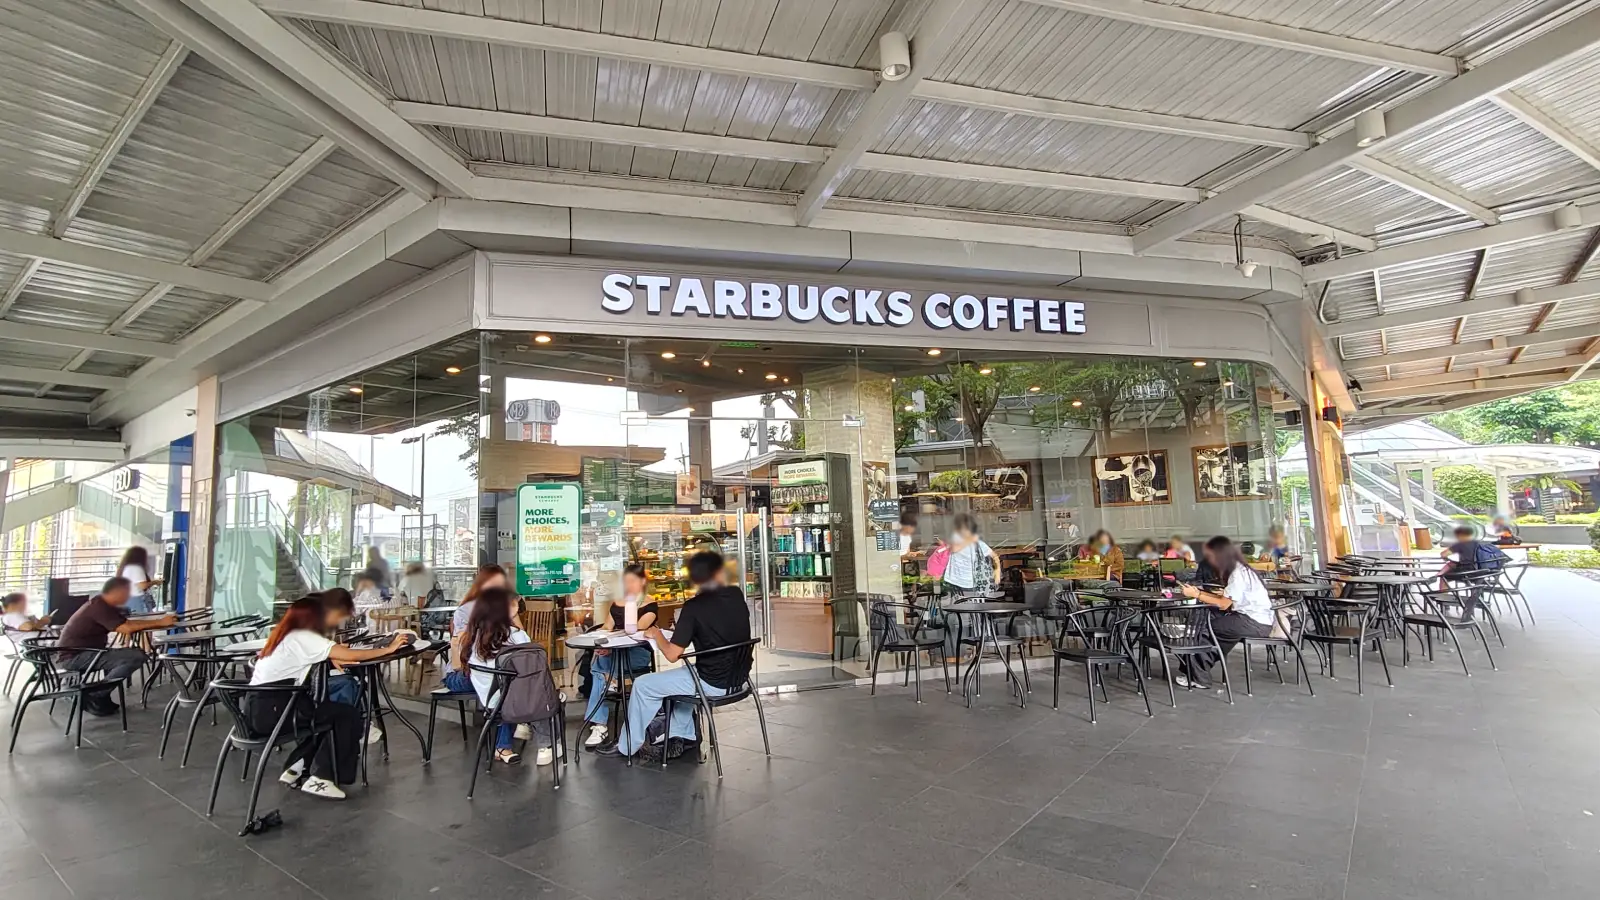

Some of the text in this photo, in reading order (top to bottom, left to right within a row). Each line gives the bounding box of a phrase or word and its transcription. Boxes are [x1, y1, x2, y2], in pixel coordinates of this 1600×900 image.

[600, 273, 1087, 335] STARBUCKS COFFEE
[525, 508, 554, 516] MORE
[525, 517, 570, 525] CHOICES,
[525, 526, 553, 534] MORE
[524, 533, 573, 542] REWARDS
